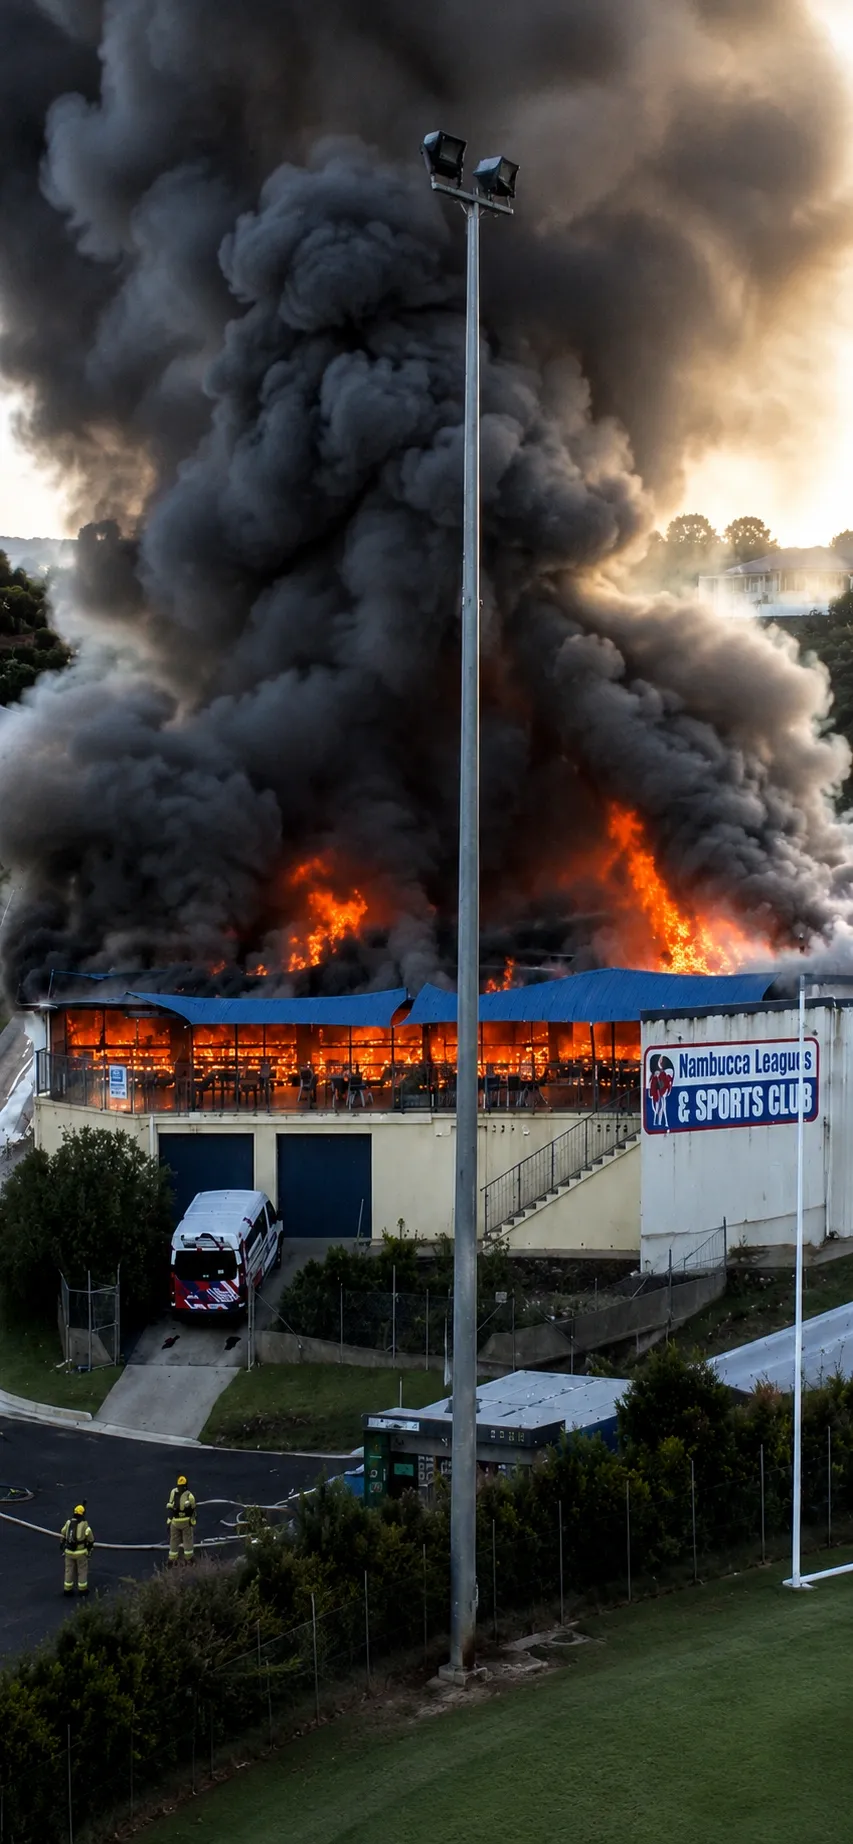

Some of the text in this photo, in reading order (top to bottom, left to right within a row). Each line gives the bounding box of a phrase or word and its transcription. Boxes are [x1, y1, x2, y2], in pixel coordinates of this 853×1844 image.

[680, 1051, 750, 1079] Nambucca
[678, 1082, 812, 1123] & SPORTS CLUB
